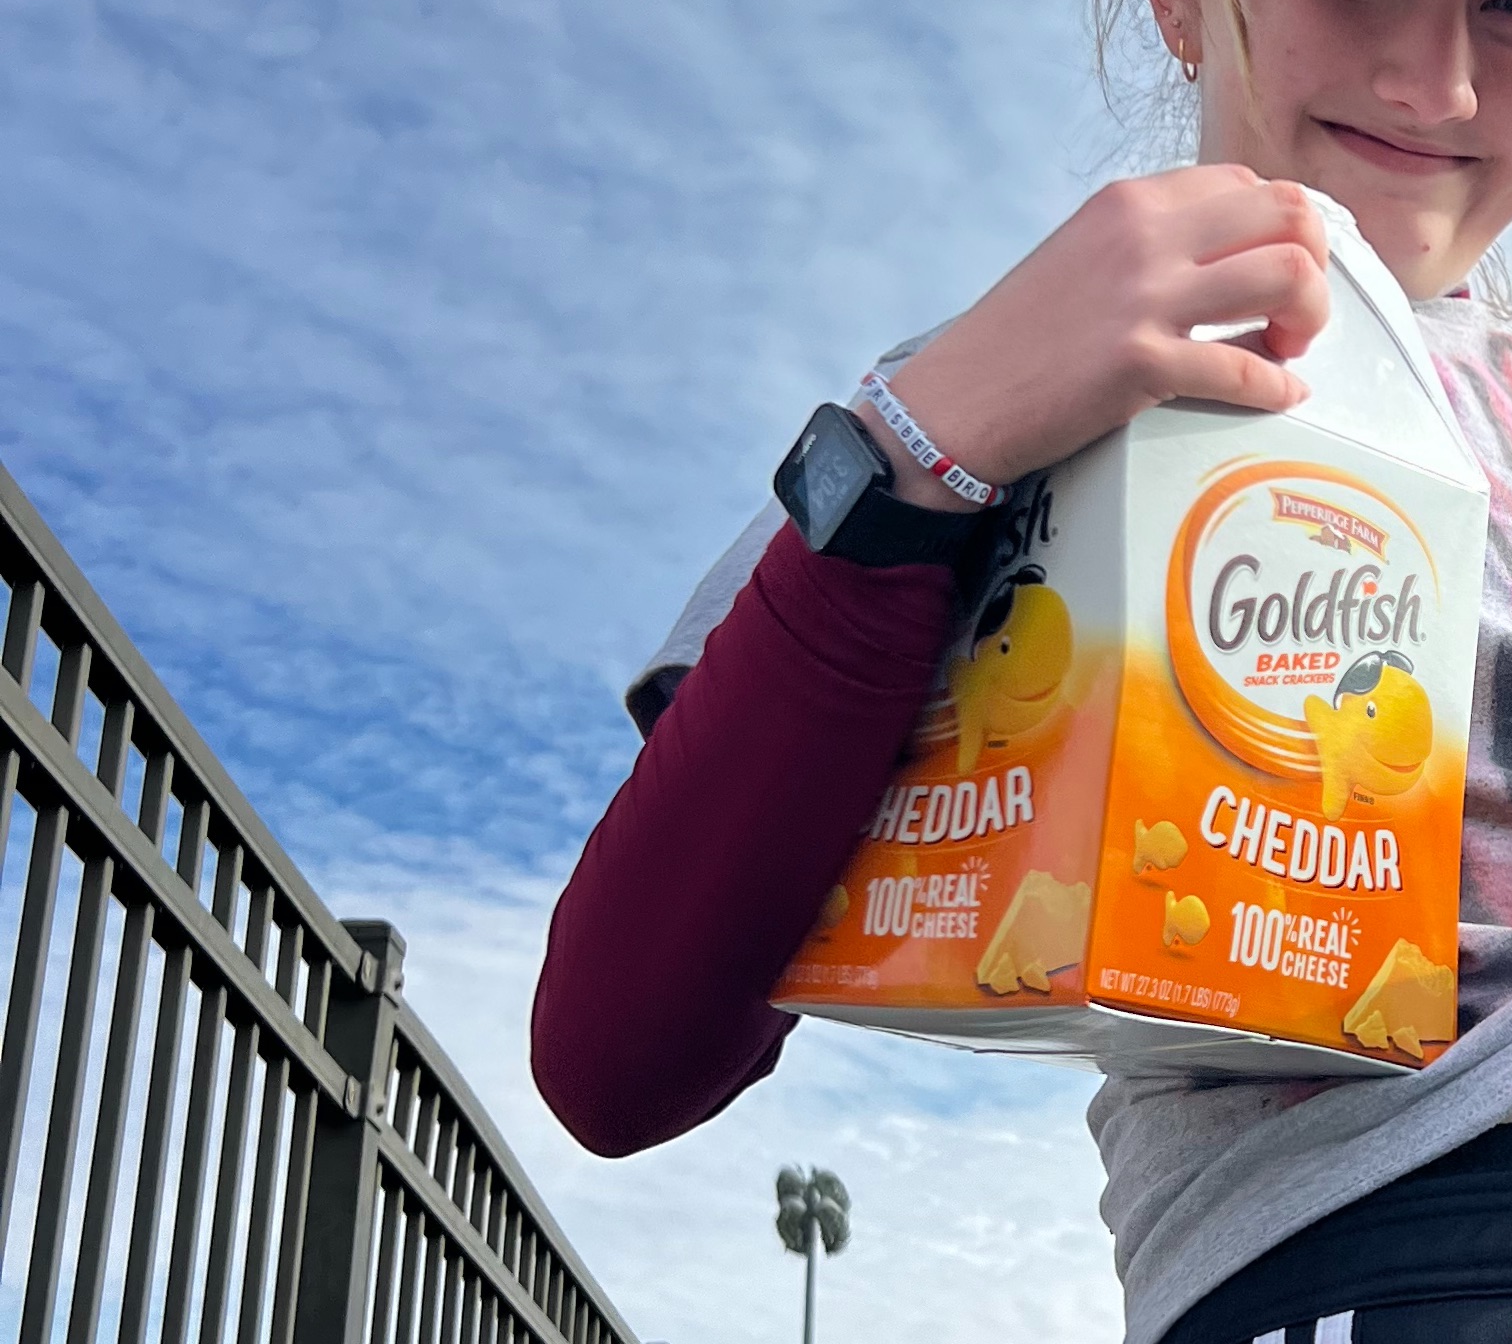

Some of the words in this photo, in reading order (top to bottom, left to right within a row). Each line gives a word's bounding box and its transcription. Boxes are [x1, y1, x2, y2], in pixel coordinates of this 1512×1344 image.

[867, 379, 937, 465] FRISBEE
[947, 469, 990, 500] BRO
[1282, 496, 1350, 531] PEPPERIDGE
[1351, 513, 1380, 547] FARM
[1209, 554, 1421, 650] Goldfish
[1244, 675, 1279, 688] SNACK
[1283, 673, 1336, 686] CRACKERS
[1256, 652, 1341, 672] BAKED
[859, 766, 1034, 843] HEDDAR
[1201, 786, 1402, 891] CHEDDAR
[926, 873, 980, 908] REAL
[911, 912, 979, 939] CHEESE
[1298, 916, 1352, 959] REAL
[1101, 968, 1120, 990] NET
[1121, 972, 1137, 993] WT
[1158, 979, 1174, 1001] OZ
[1282, 950, 1350, 989] CHEESE
